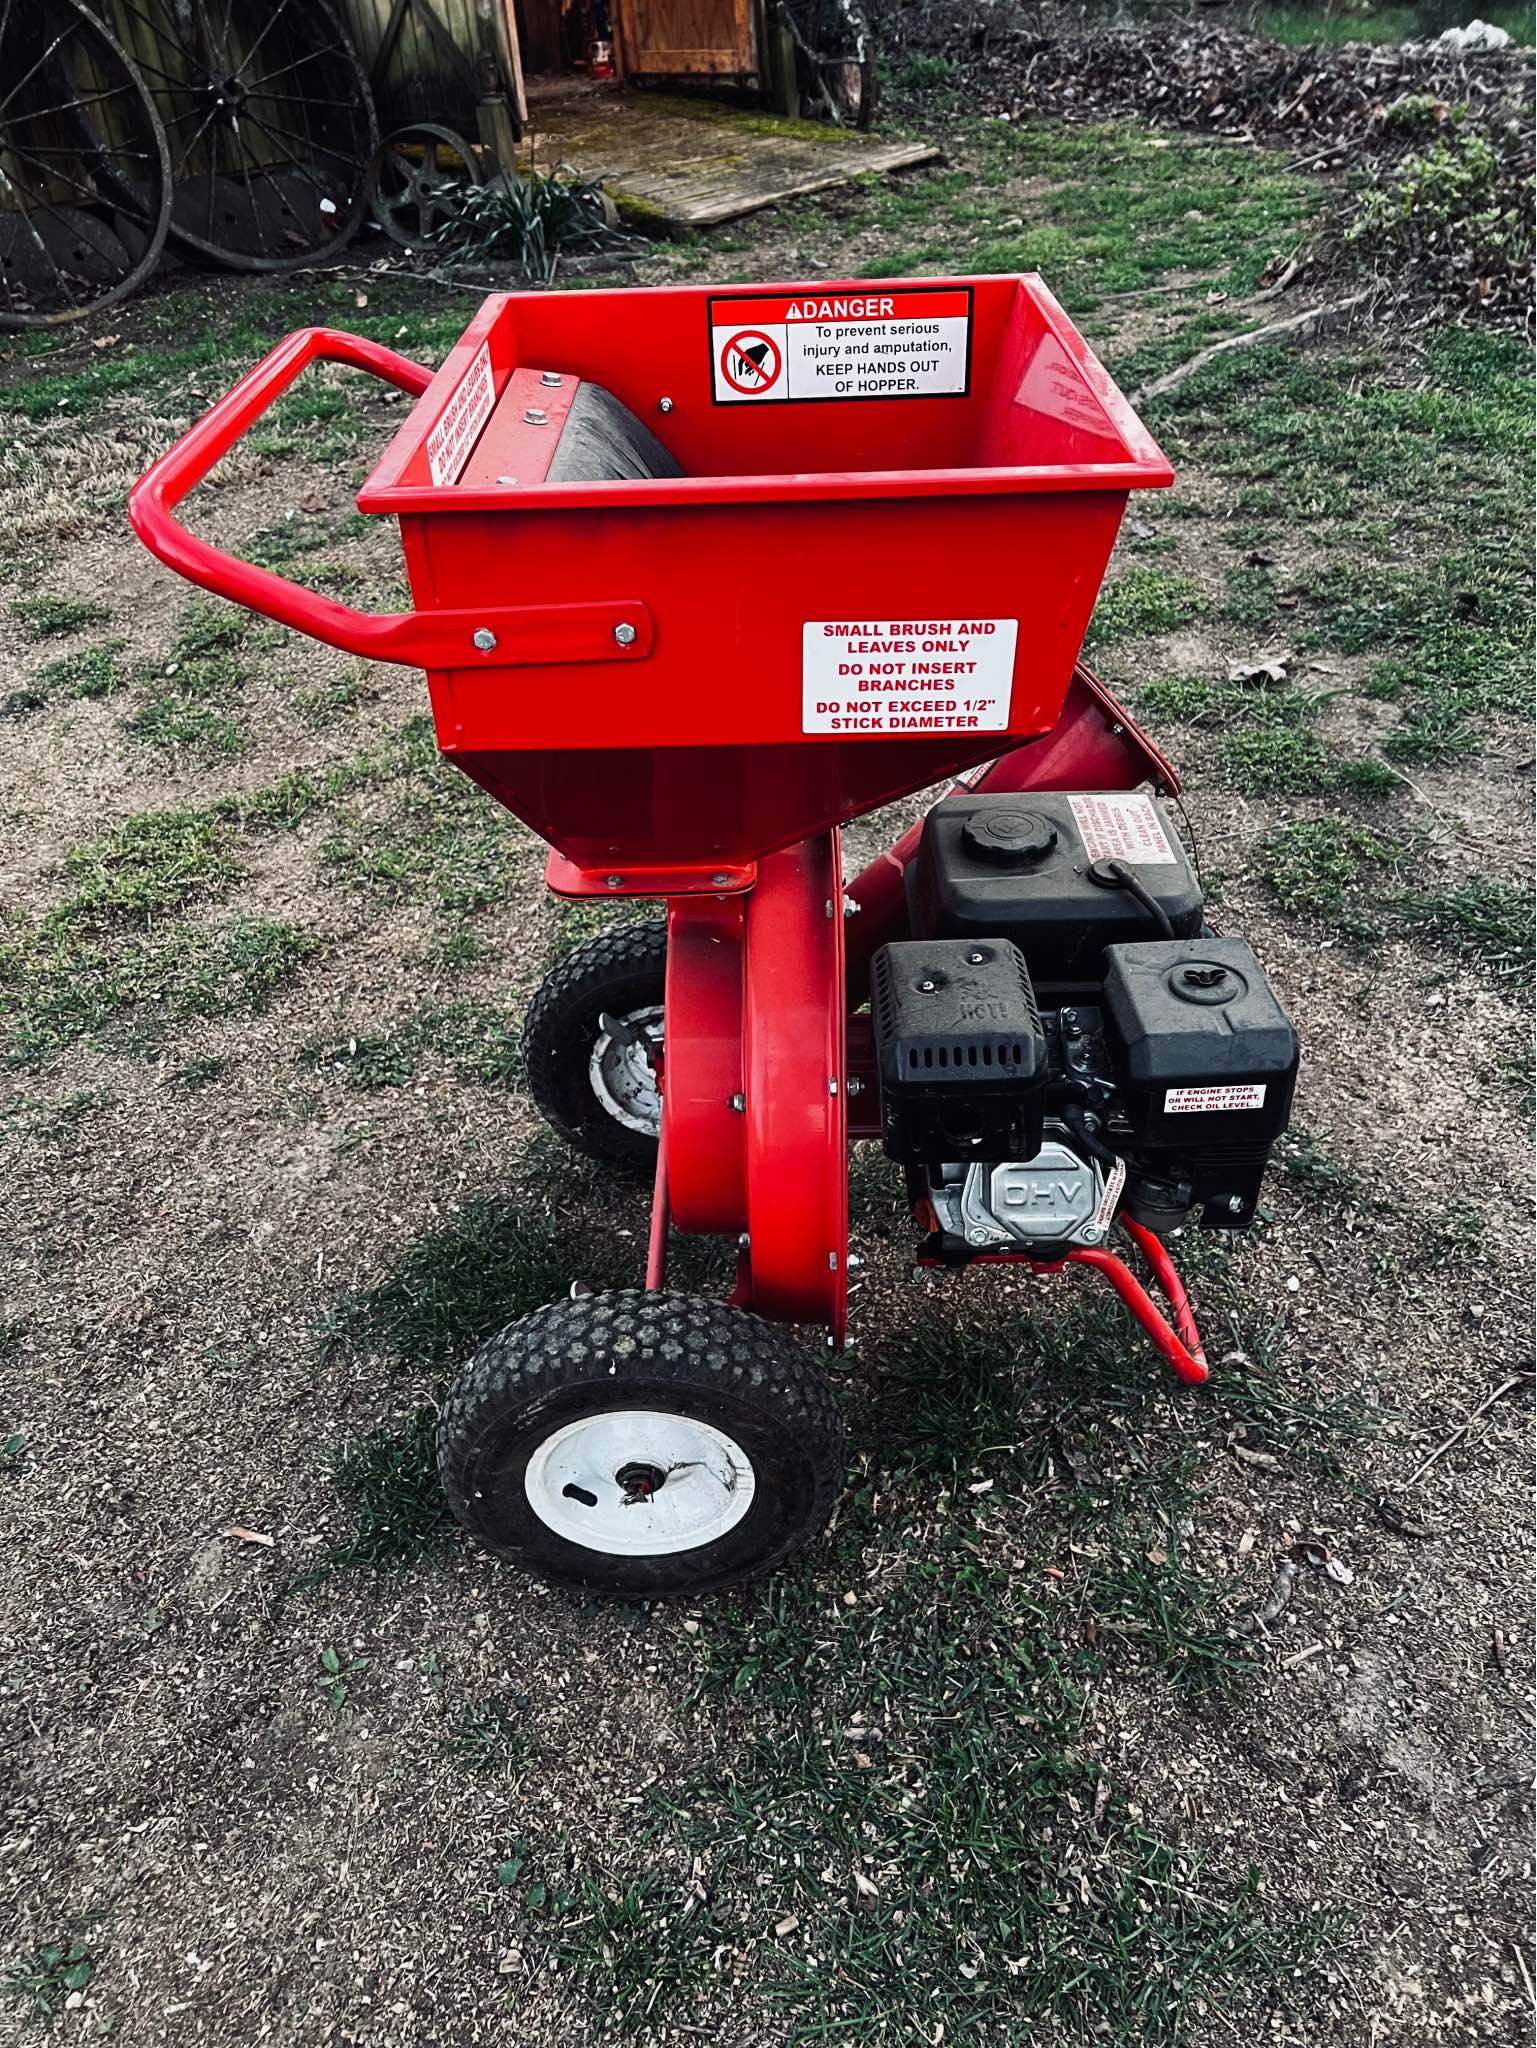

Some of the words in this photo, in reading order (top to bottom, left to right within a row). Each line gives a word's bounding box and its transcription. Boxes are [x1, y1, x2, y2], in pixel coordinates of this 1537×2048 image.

[803, 299, 893, 319] DANGER
[816, 326, 831, 337] To
[836, 325, 886, 339] prevent
[890, 323, 939, 335] serious
[803, 343, 840, 358] injury
[845, 344, 869, 355] and
[873, 341, 952, 357] amputation,
[816, 364, 853, 376] KEEP
[857, 362, 905, 374] HANDS
[910, 361, 939, 372] OUT
[835, 381, 853, 392] OF
[858, 379, 918, 391] HOPPER.
[823, 625, 883, 636] SMALL
[889, 624, 951, 635] BRUSH
[957, 623, 996, 634] AND
[848, 641, 915, 653] LEAVES
[922, 640, 970, 652] ONLY
[838, 663, 862, 675] DO
[869, 663, 905, 674] NOT
[912, 662, 977, 674] INSERT
[858, 679, 955, 691] BRANCHES
[816, 702, 840, 713] DO
[846, 702, 882, 713] NOT
[888, 701, 957, 712] EXCEED
[963, 700, 996, 711] 1/2"
[831, 717, 883, 729] STICK
[889, 716, 978, 728] DIAMETER
[1072, 802, 1084, 815] NOT
[1138, 804, 1153, 822] BACK
[1077, 816, 1091, 832] WILL
[1129, 811, 1142, 824] OUT
[1147, 823, 1157, 831] IN
[1120, 833, 1135, 851] WITH
[1135, 825, 1152, 847] CLEAN
[1151, 832, 1168, 854] PANEL
[1083, 832, 1100, 859] ENGINE
[1099, 842, 1113, 859] TART
[1004, 1181, 1082, 1206] OHV
